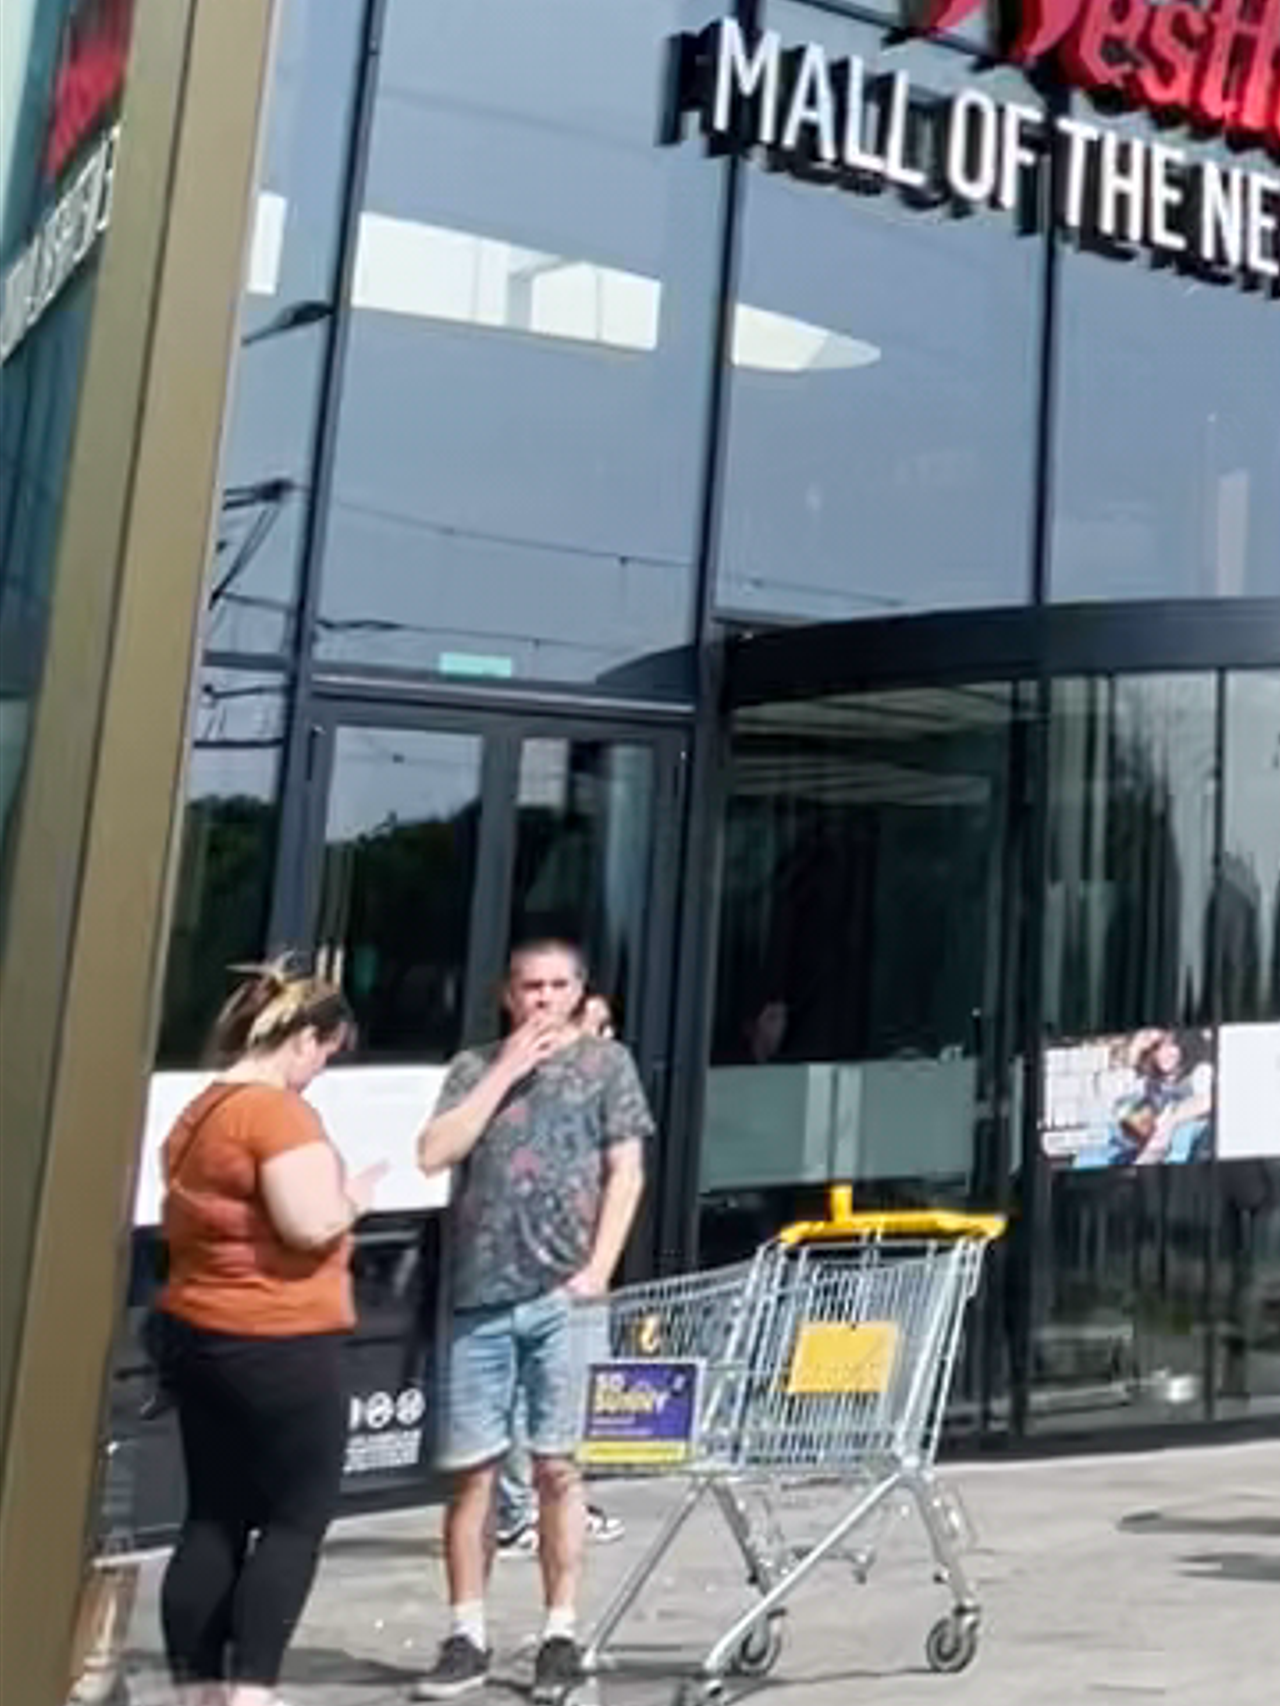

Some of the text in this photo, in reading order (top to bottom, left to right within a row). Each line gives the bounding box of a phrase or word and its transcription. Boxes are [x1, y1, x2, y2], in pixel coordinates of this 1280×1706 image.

[712, 15, 925, 186] MALL
[947, 89, 1044, 211] OF
[1055, 116, 1187, 251] THE
